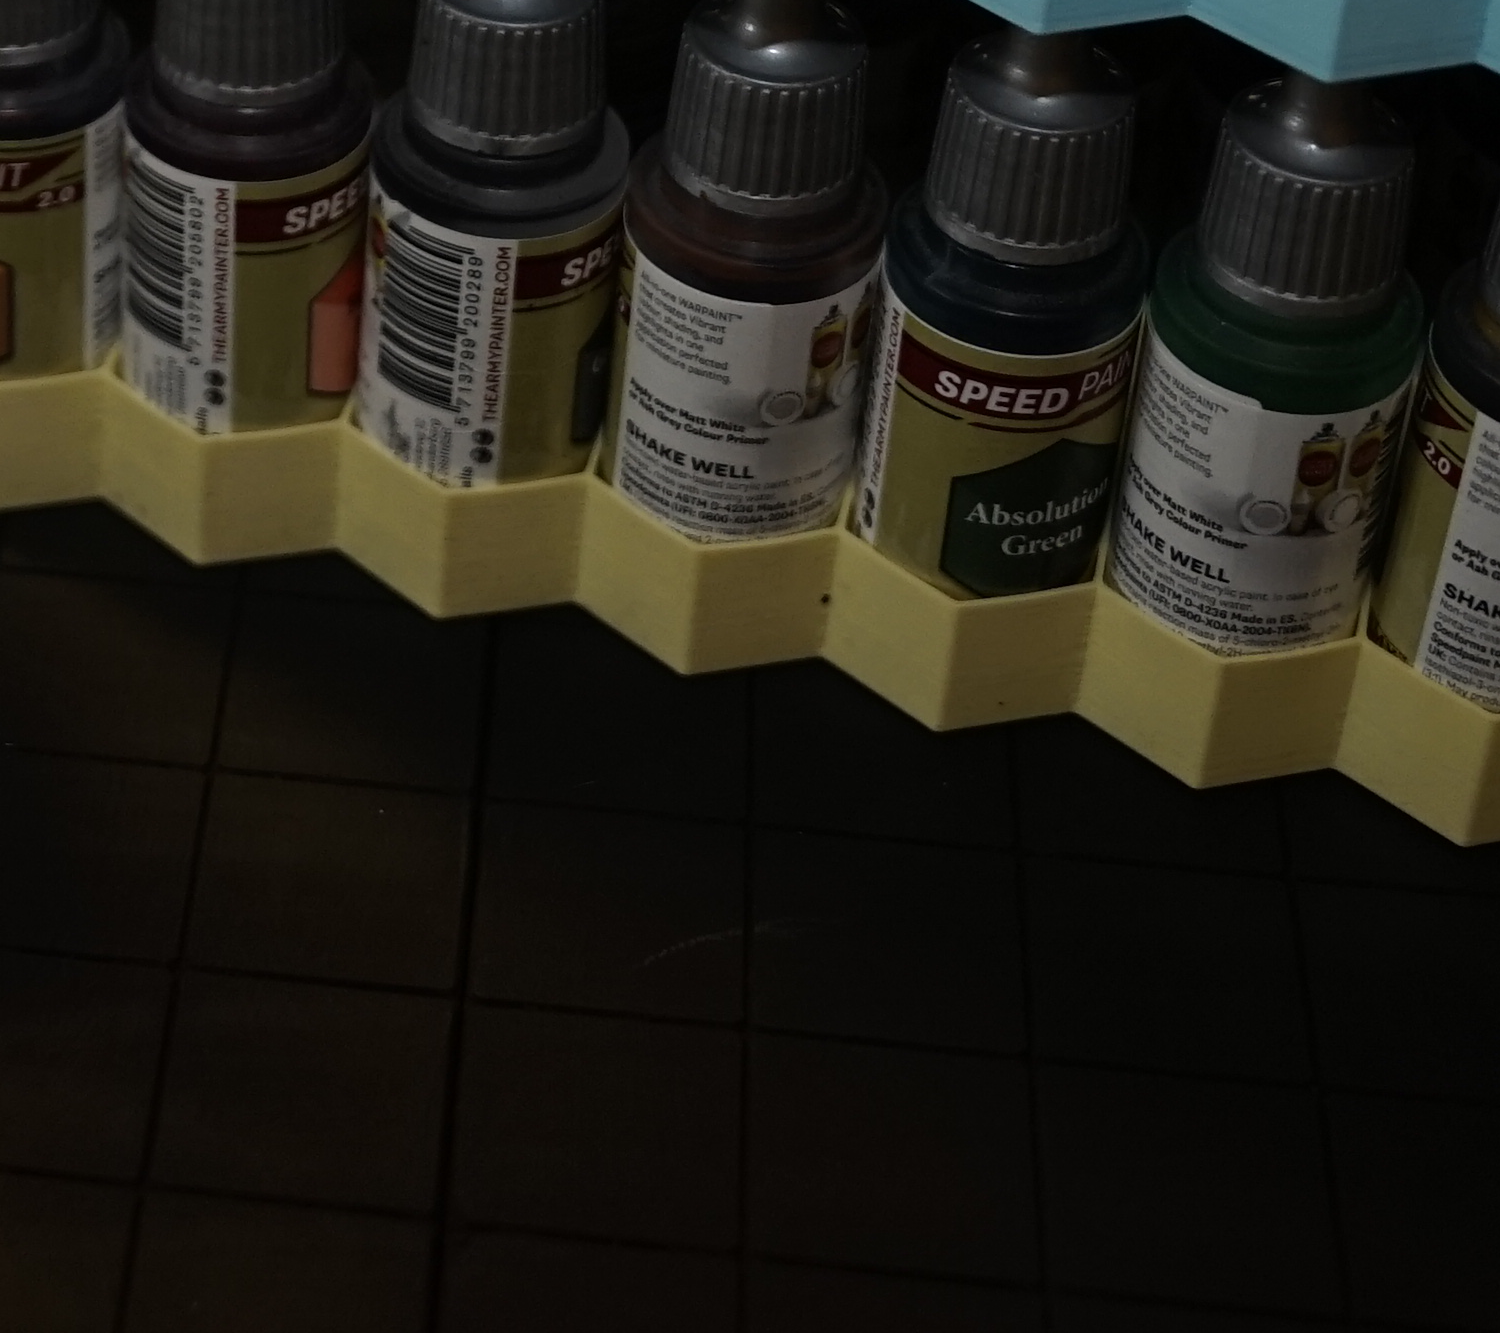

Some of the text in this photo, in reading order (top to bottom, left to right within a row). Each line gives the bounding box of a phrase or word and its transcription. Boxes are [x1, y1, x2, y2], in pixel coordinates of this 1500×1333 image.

[36, 184, 77, 209] 2.0
[211, 187, 231, 365] THEARMYPAINTER.COM
[456, 255, 484, 409] 713799 200289
[481, 246, 512, 423] THEARMYPAINTER.COM
[686, 340, 704, 352] one
[704, 334, 724, 345] and
[870, 306, 902, 488] THEARMYPAINTER.COM
[933, 350, 1132, 416] SPEED PAIN
[679, 406, 707, 426] Matt
[709, 418, 746, 433] White
[683, 422, 724, 441] Colour
[626, 418, 754, 479] SHAKE WELL
[1420, 439, 1452, 476] 2.0
[964, 477, 1109, 526] Absolution
[1163, 493, 1225, 533] Matt White
[1000, 523, 1084, 557] Green
[1165, 509, 1248, 551] Colour Primer
[1170, 546, 1230, 584] WELL
[1451, 552, 1465, 563] or
[1466, 559, 1489, 577] Ash
[1454, 539, 1488, 565] Apply
[1153, 579, 1183, 603] ASTM
[1184, 596, 1228, 619] D-4236
[1230, 612, 1264, 625] Made
[1201, 582, 1237, 599] acrylic
[1427, 643, 1447, 662] UK:
[1430, 632, 1491, 667] Speedpaint
[1433, 621, 1487, 653] Conforms
